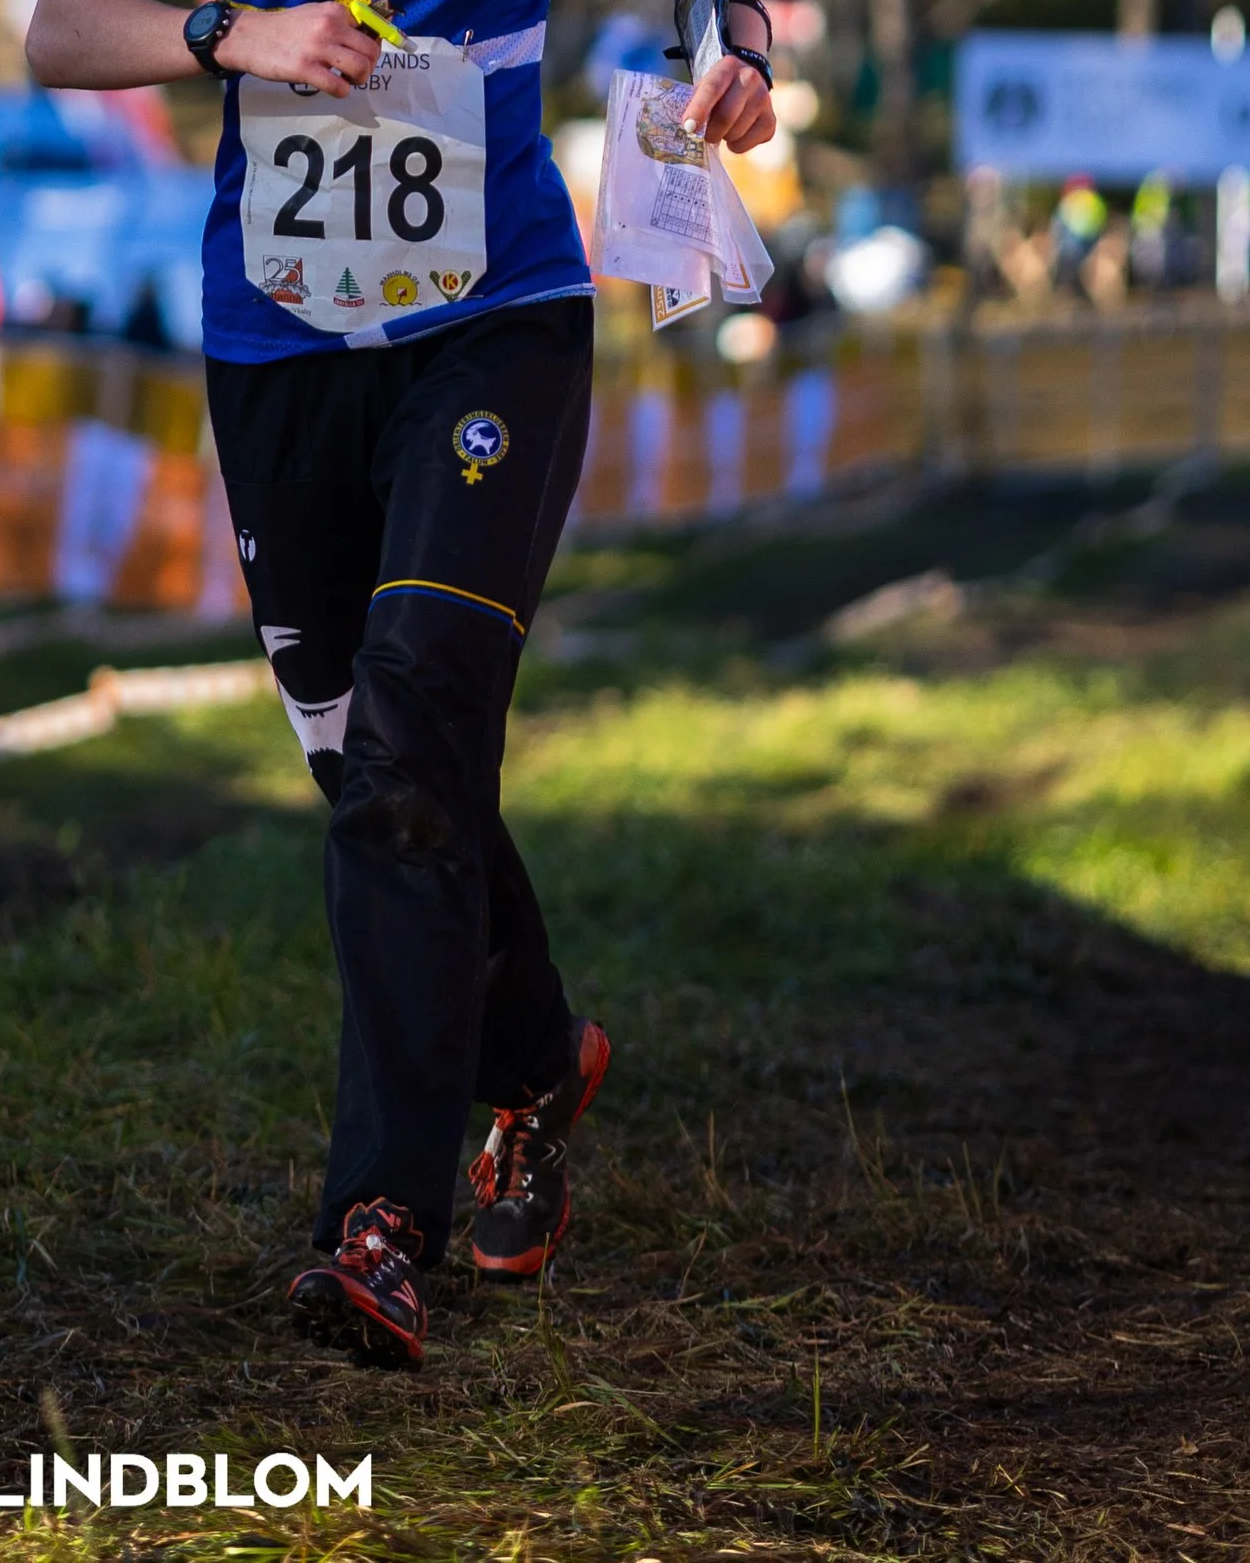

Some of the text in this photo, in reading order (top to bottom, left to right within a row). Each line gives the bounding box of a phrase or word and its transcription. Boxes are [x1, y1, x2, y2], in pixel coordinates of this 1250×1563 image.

[375, 53, 430, 70] ANDS
[273, 134, 445, 242] 218
[265, 257, 300, 284] 25
